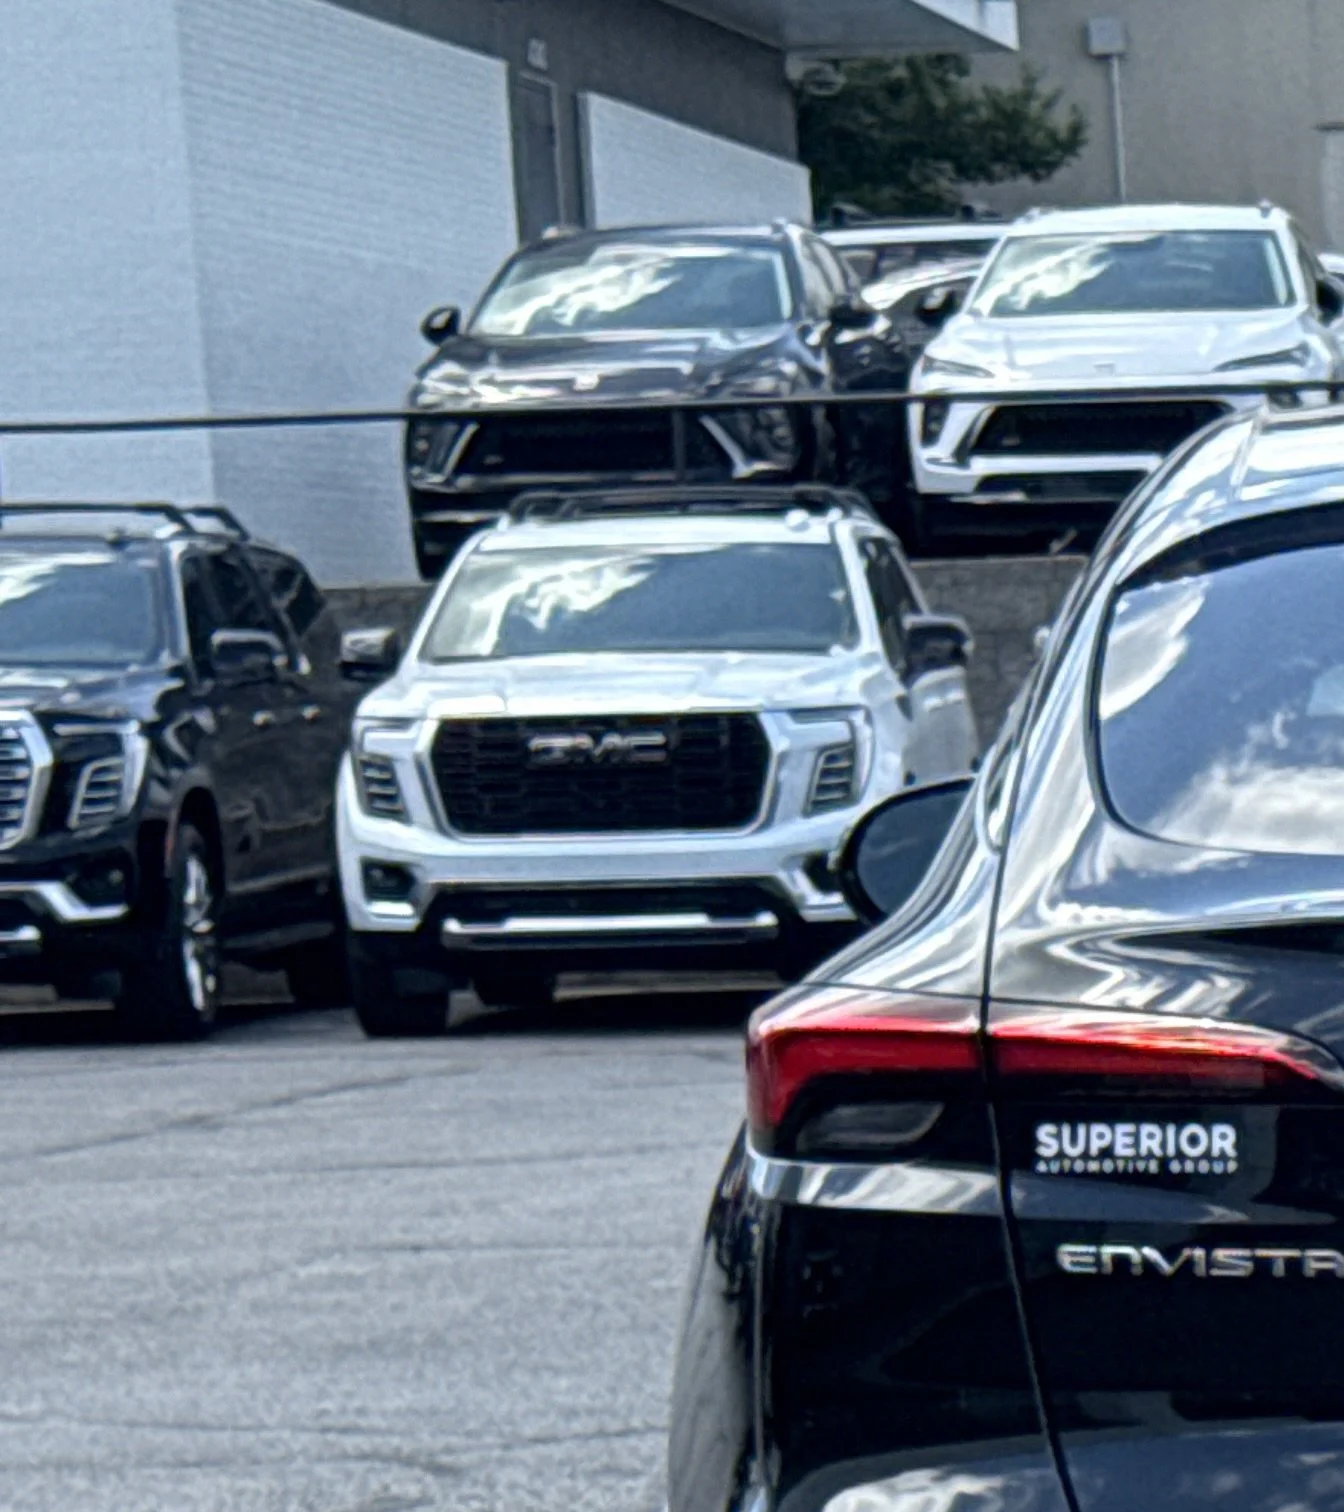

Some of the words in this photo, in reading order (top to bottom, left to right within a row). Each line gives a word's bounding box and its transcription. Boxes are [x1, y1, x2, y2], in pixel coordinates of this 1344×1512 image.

[527, 732, 667, 766] GMC
[1035, 1123, 1238, 1158] SUPERIOR
[1035, 1159, 1160, 1174] AUTOMOTIVE
[1169, 1159, 1239, 1174] GROUP
